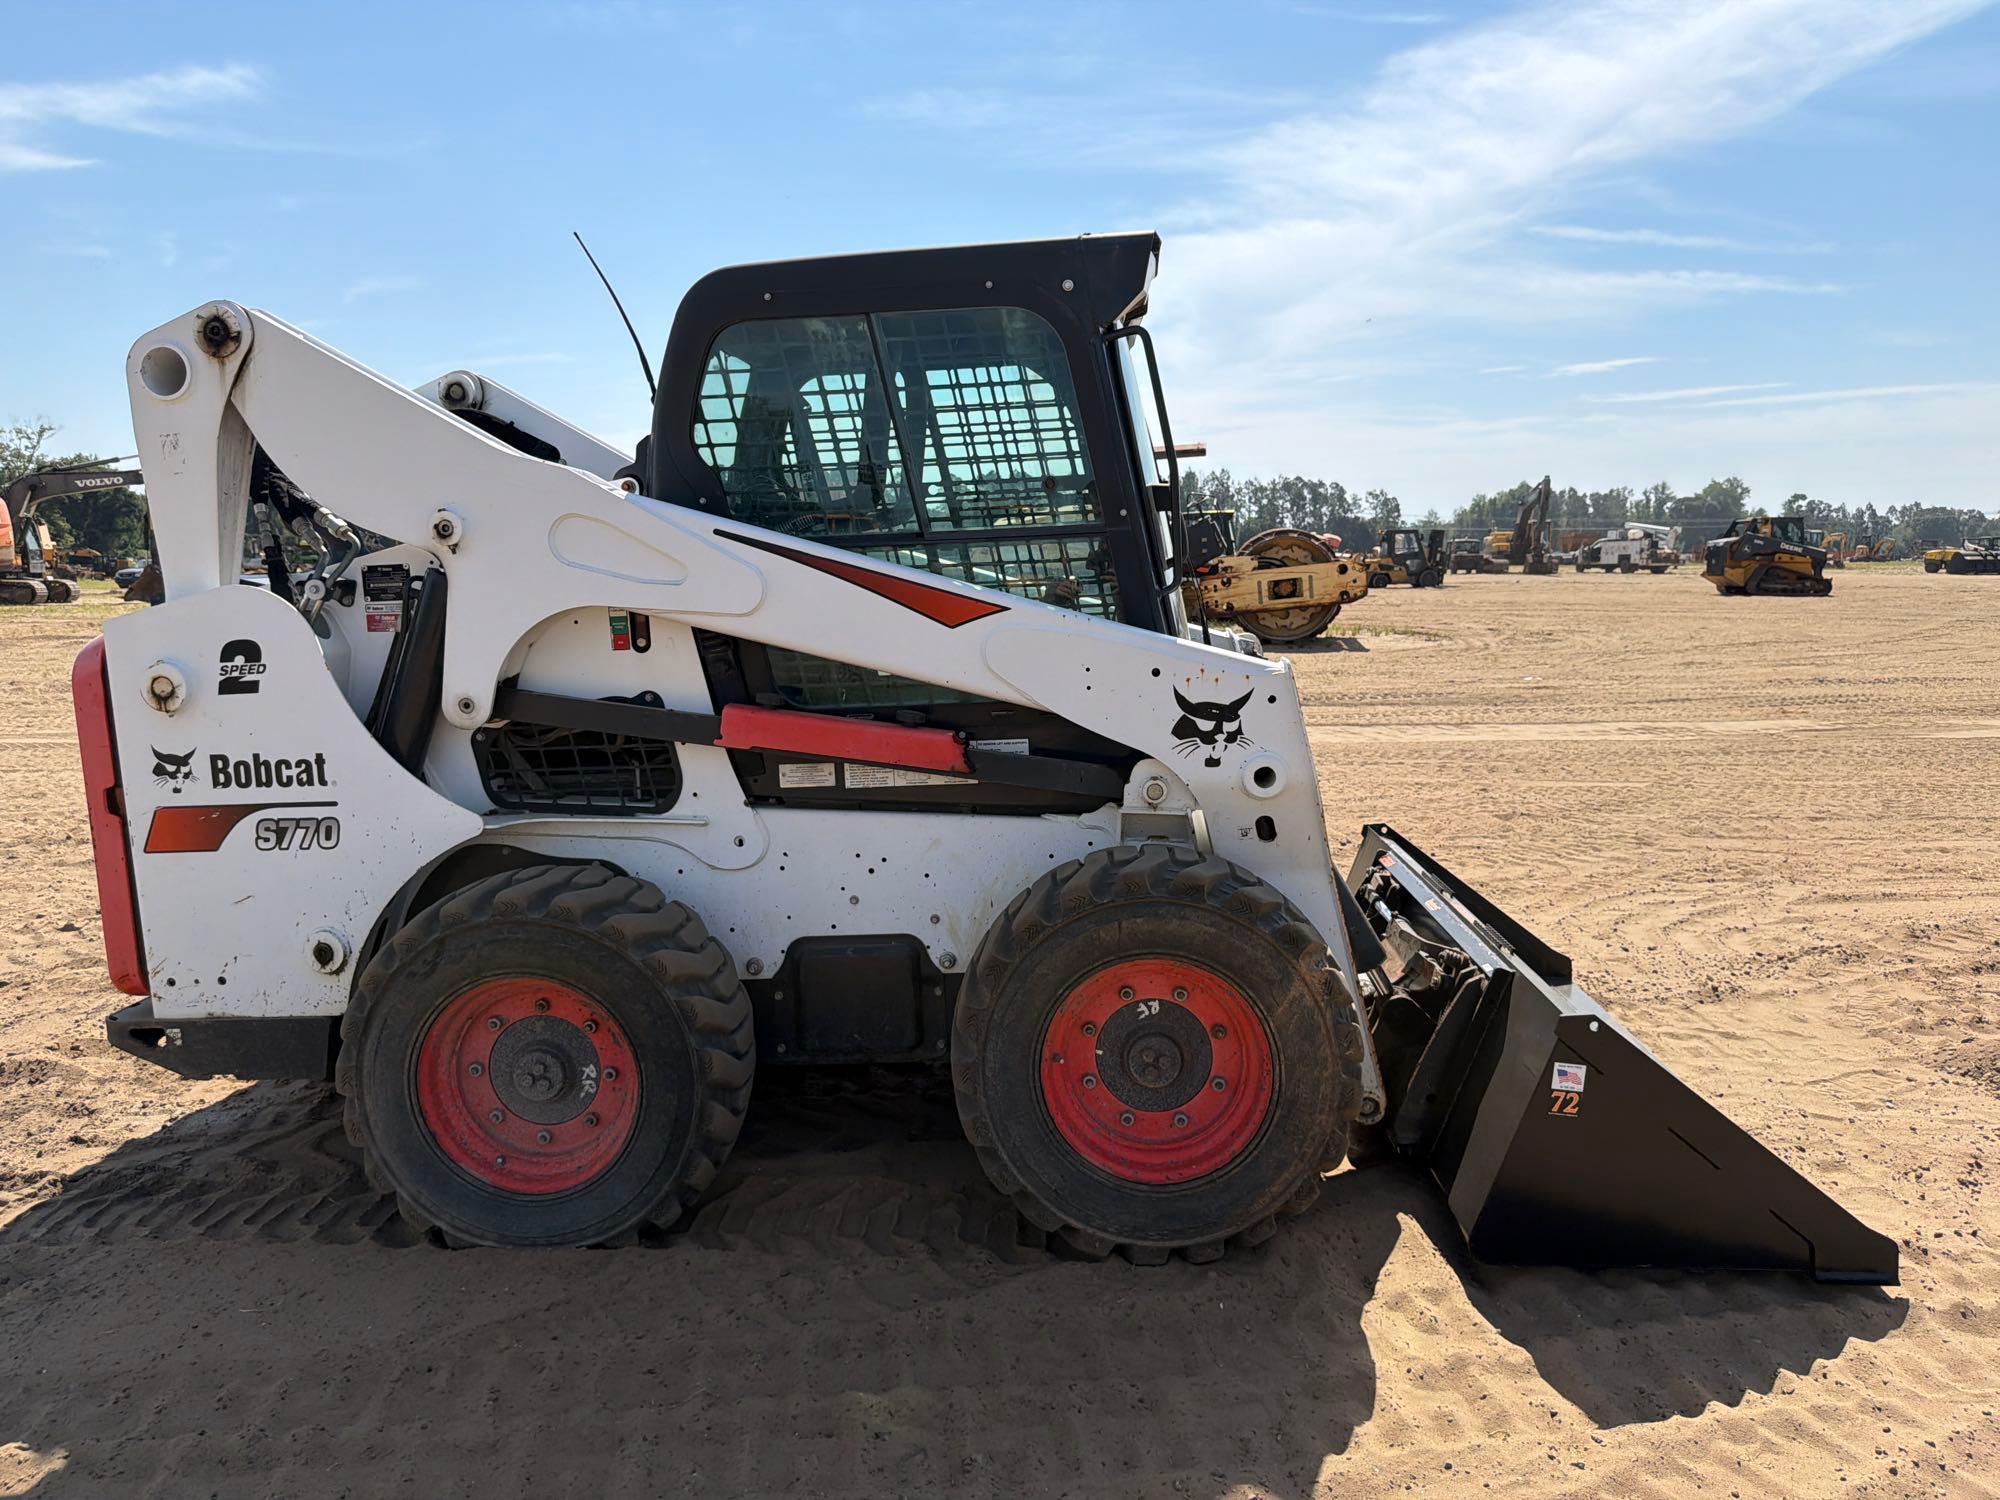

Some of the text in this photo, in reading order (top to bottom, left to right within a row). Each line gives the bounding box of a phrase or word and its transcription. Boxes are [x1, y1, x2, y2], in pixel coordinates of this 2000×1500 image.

[75, 476, 124, 488] VOLVO
[1780, 542, 1803, 553] DEERE
[217, 638, 263, 695] 2
[219, 663, 267, 677] SPEED
[209, 753, 328, 789] Bobcat
[255, 816, 341, 851] S770
[1551, 1091, 1580, 1115] 72
